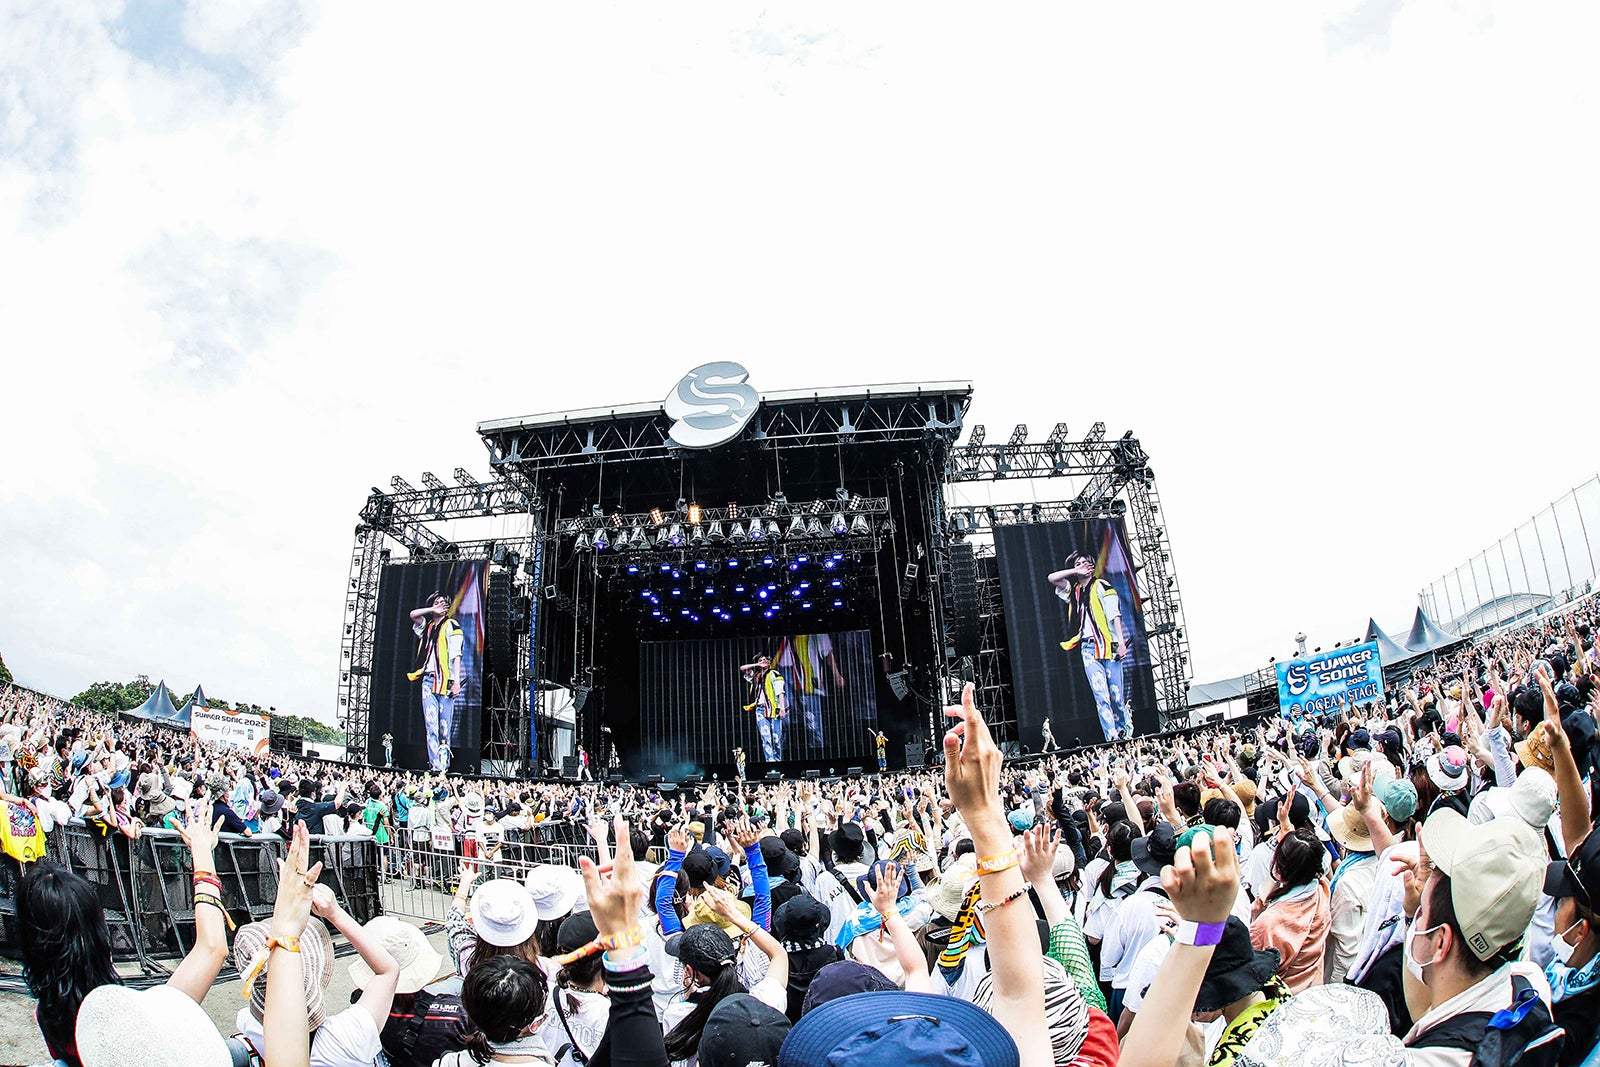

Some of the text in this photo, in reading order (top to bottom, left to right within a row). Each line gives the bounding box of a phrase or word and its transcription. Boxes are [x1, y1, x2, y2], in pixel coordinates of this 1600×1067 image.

[1309, 650, 1372, 675] SUMMER
[1320, 663, 1367, 685] SONIC
[1346, 675, 1369, 686] 2022
[1305, 683, 1377, 714] OCEAN STAGE
[194, 711, 267, 728] SUMMER SONIC 2022
[1473, 936, 1485, 950] KIU
